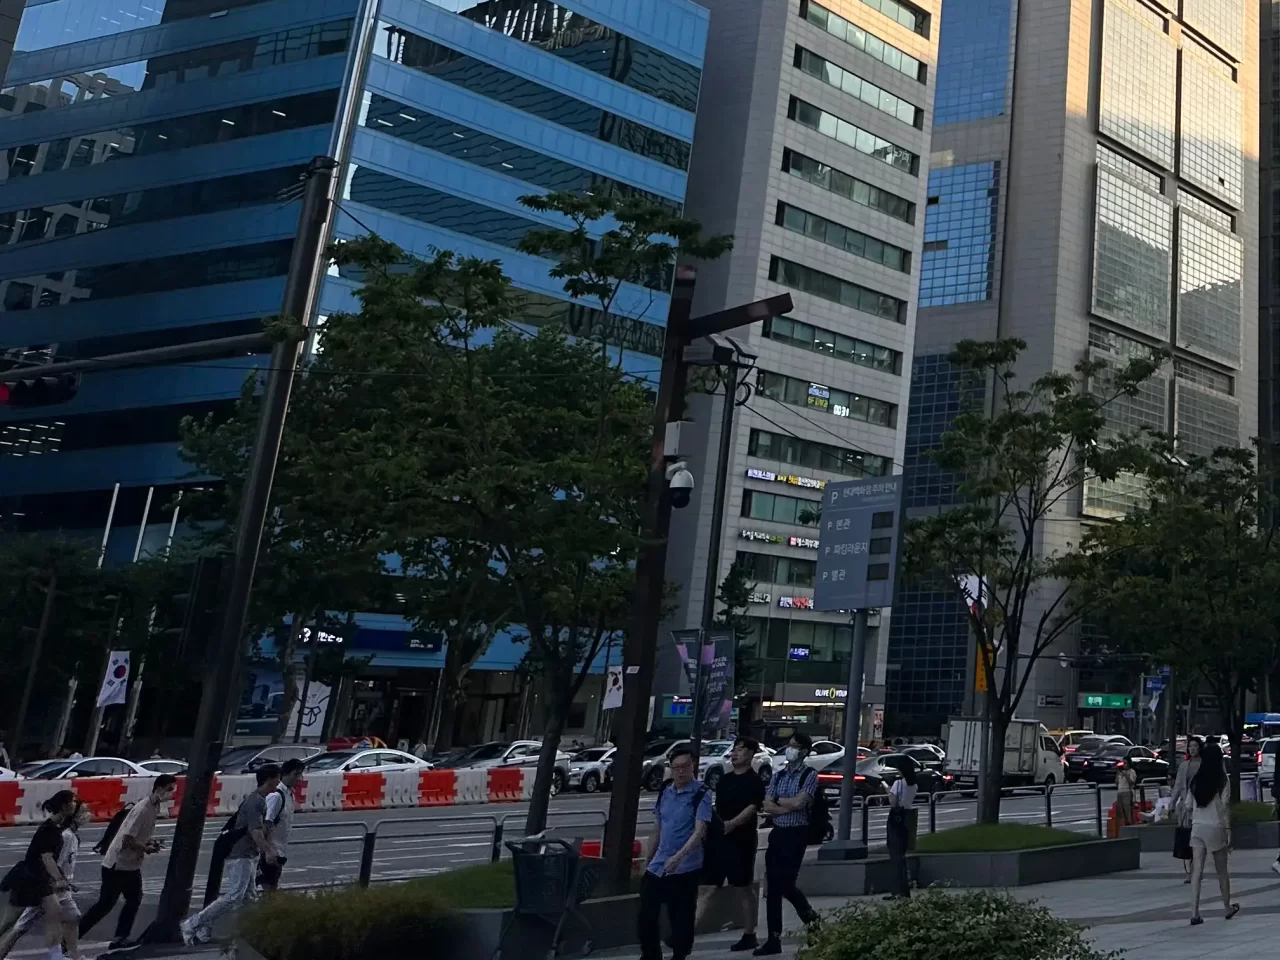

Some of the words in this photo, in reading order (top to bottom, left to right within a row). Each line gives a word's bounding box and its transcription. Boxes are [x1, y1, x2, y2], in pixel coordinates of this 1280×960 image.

[831, 491, 839, 504] P
[827, 521, 833, 530] P
[825, 546, 831, 555] P
[833, 542, 868, 556] 파킹라운지
[822, 572, 829, 581] P
[815, 689, 830, 697] OLIVE
